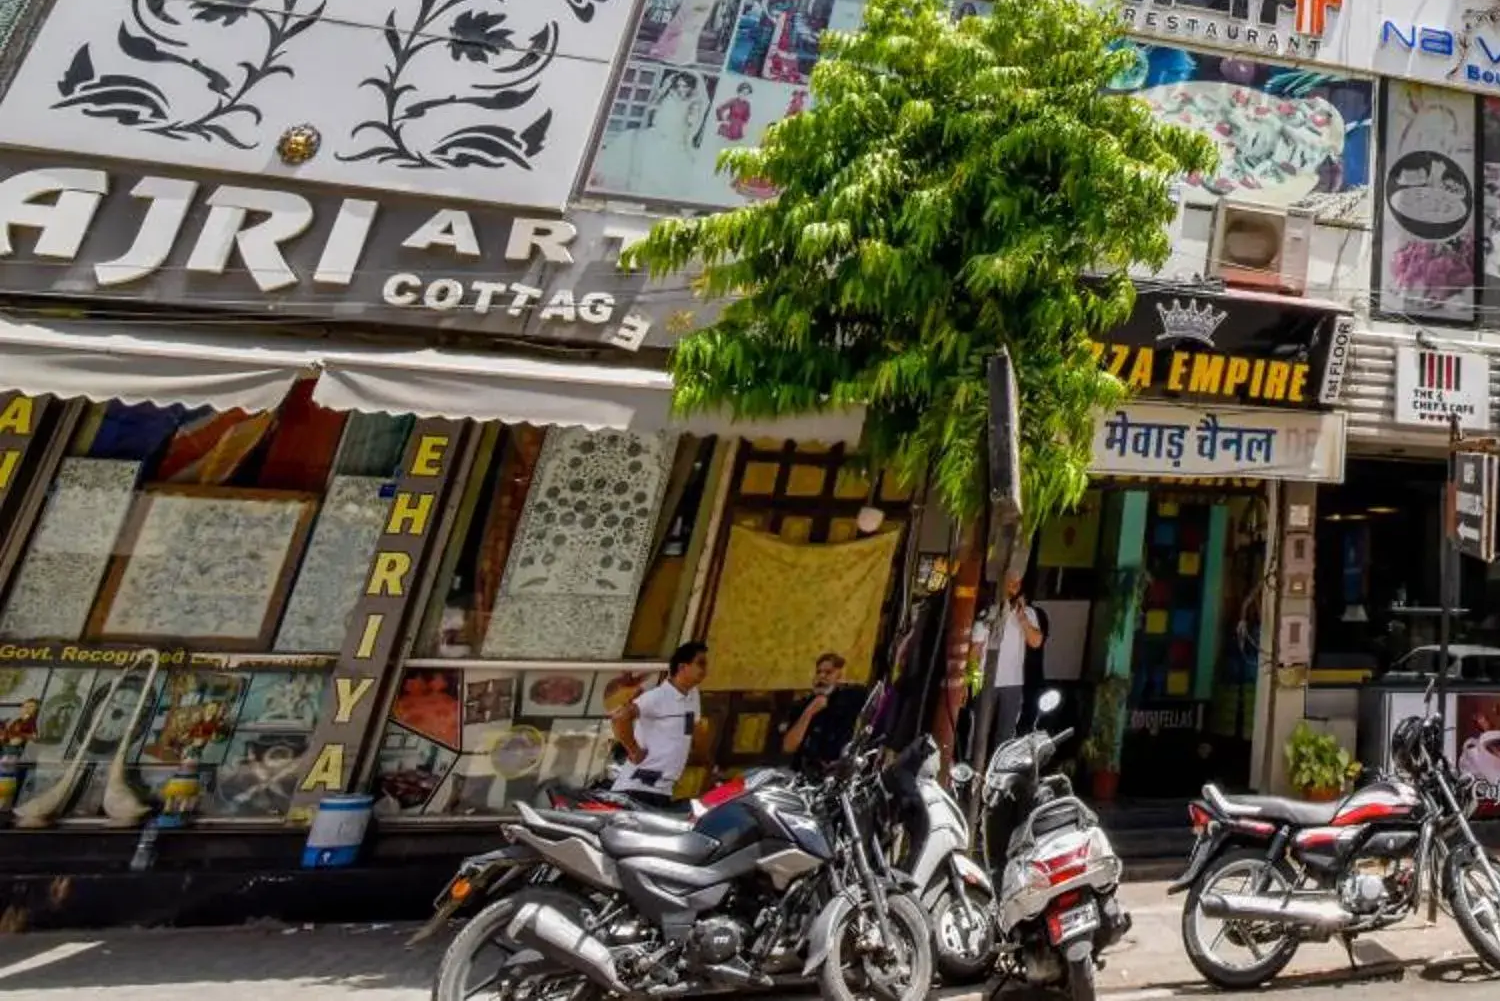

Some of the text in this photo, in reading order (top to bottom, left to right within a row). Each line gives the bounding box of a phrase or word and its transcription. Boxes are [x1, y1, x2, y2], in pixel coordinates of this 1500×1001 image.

[1123, 7, 1322, 58] RESTAURANT
[1167, 351, 1310, 401] EMPIRE
[1330, 323, 1351, 380] FLOOR
[1105, 410, 1190, 468] मेवाड़
[1196, 413, 1277, 464] चैनल
